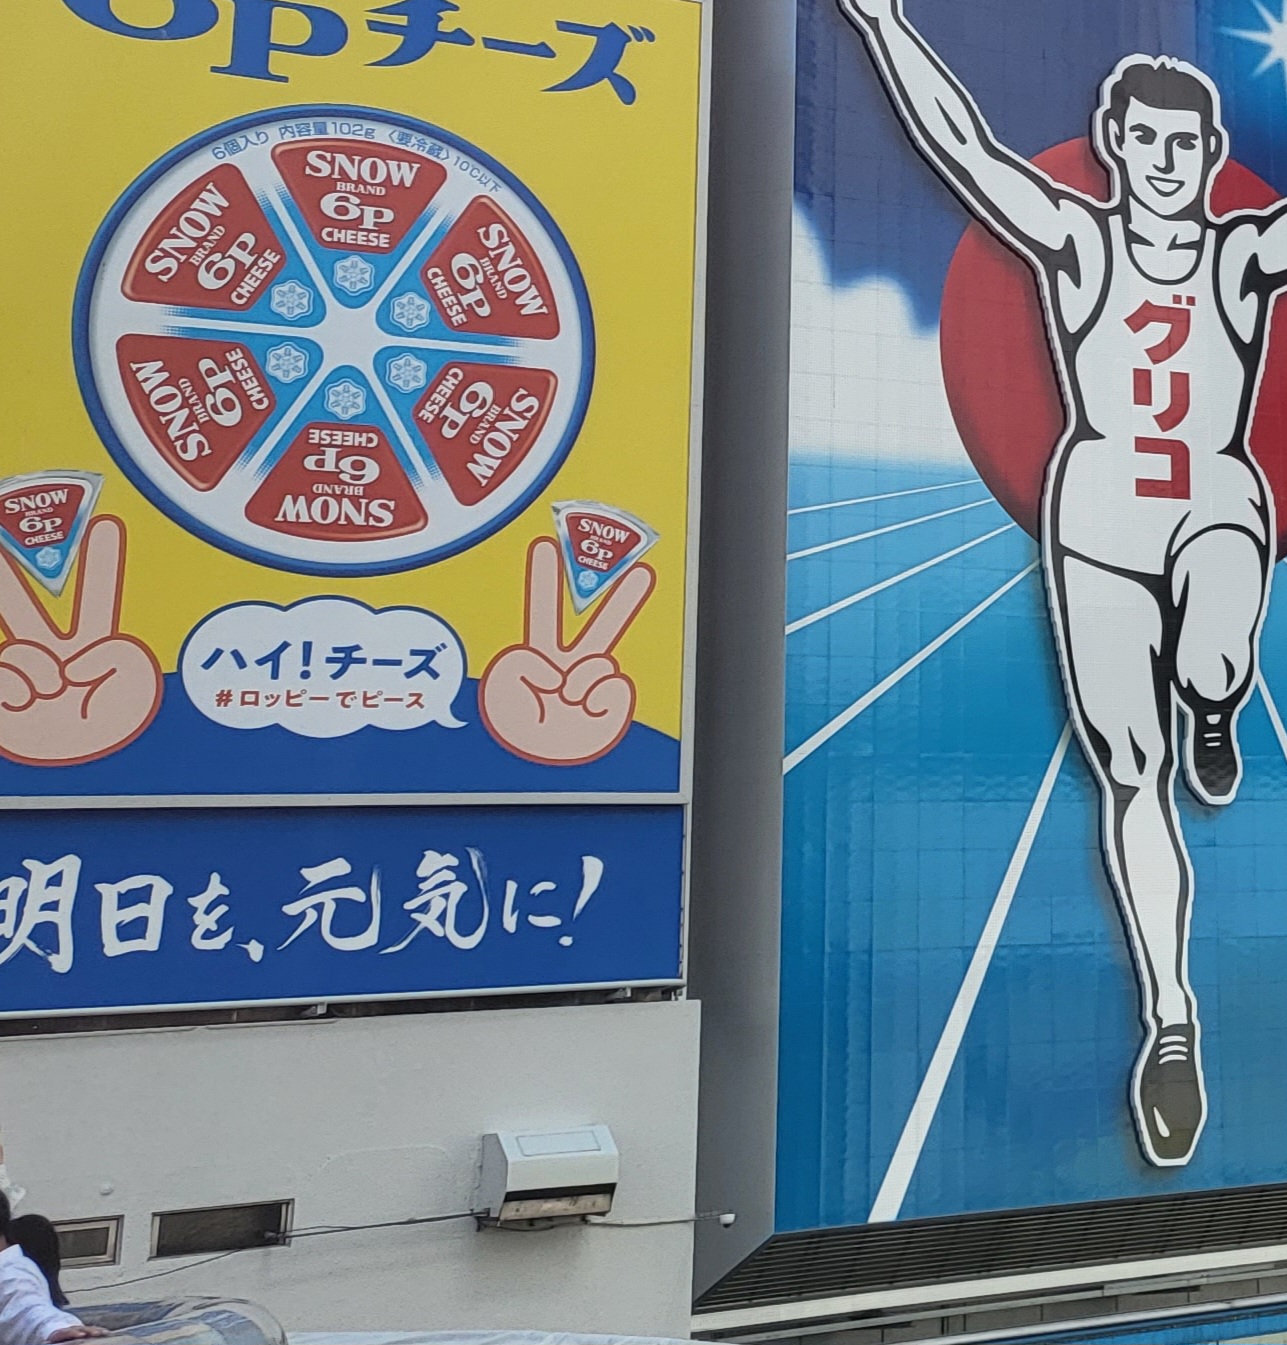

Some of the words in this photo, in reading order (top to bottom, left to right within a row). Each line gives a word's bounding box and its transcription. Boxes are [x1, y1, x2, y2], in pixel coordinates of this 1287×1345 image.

[211, 130, 269, 160] 6個入り
[278, 120, 377, 141] 内容量102g
[304, 150, 421, 188] SNOW
[336, 181, 386, 197] BRAND
[320, 192, 394, 230] 6P
[144, 182, 230, 283] SNOW
[188, 224, 226, 266] BRAND
[321, 227, 391, 248] CHEESE
[197, 232, 259, 290] 6P
[230, 248, 281, 305] CHEESE
[476, 223, 549, 316] SNOW
[480, 258, 509, 300] BRAND
[426, 267, 468, 327] CHEESE
[450, 252, 492, 318] 6P
[198, 358, 243, 427] 6P
[225, 347, 270, 410] CHEESE
[418, 367, 464, 424] CHEESE
[1123, 293, 1196, 501] グリコ
[130, 359, 212, 461] SNOW
[178, 377, 210, 424] BRAND
[440, 381, 494, 440] 6P
[308, 428, 379, 447] CHEESE
[466, 387, 540, 487] SNOW
[469, 403, 502, 445] BRAND
[303, 447, 381, 485] 6P
[4, 488, 69, 514] SNOW
[275, 494, 397, 527] SNOW
[312, 483, 364, 496] BRAND
[19, 516, 62, 533] 6P
[24, 531, 64, 545] CHEESE
[577, 518, 631, 544] SNOW
[577, 555, 610, 570] CHEESE
[580, 539, 614, 561] 6P
[215, 689, 426, 709] #ロッピーでピース
